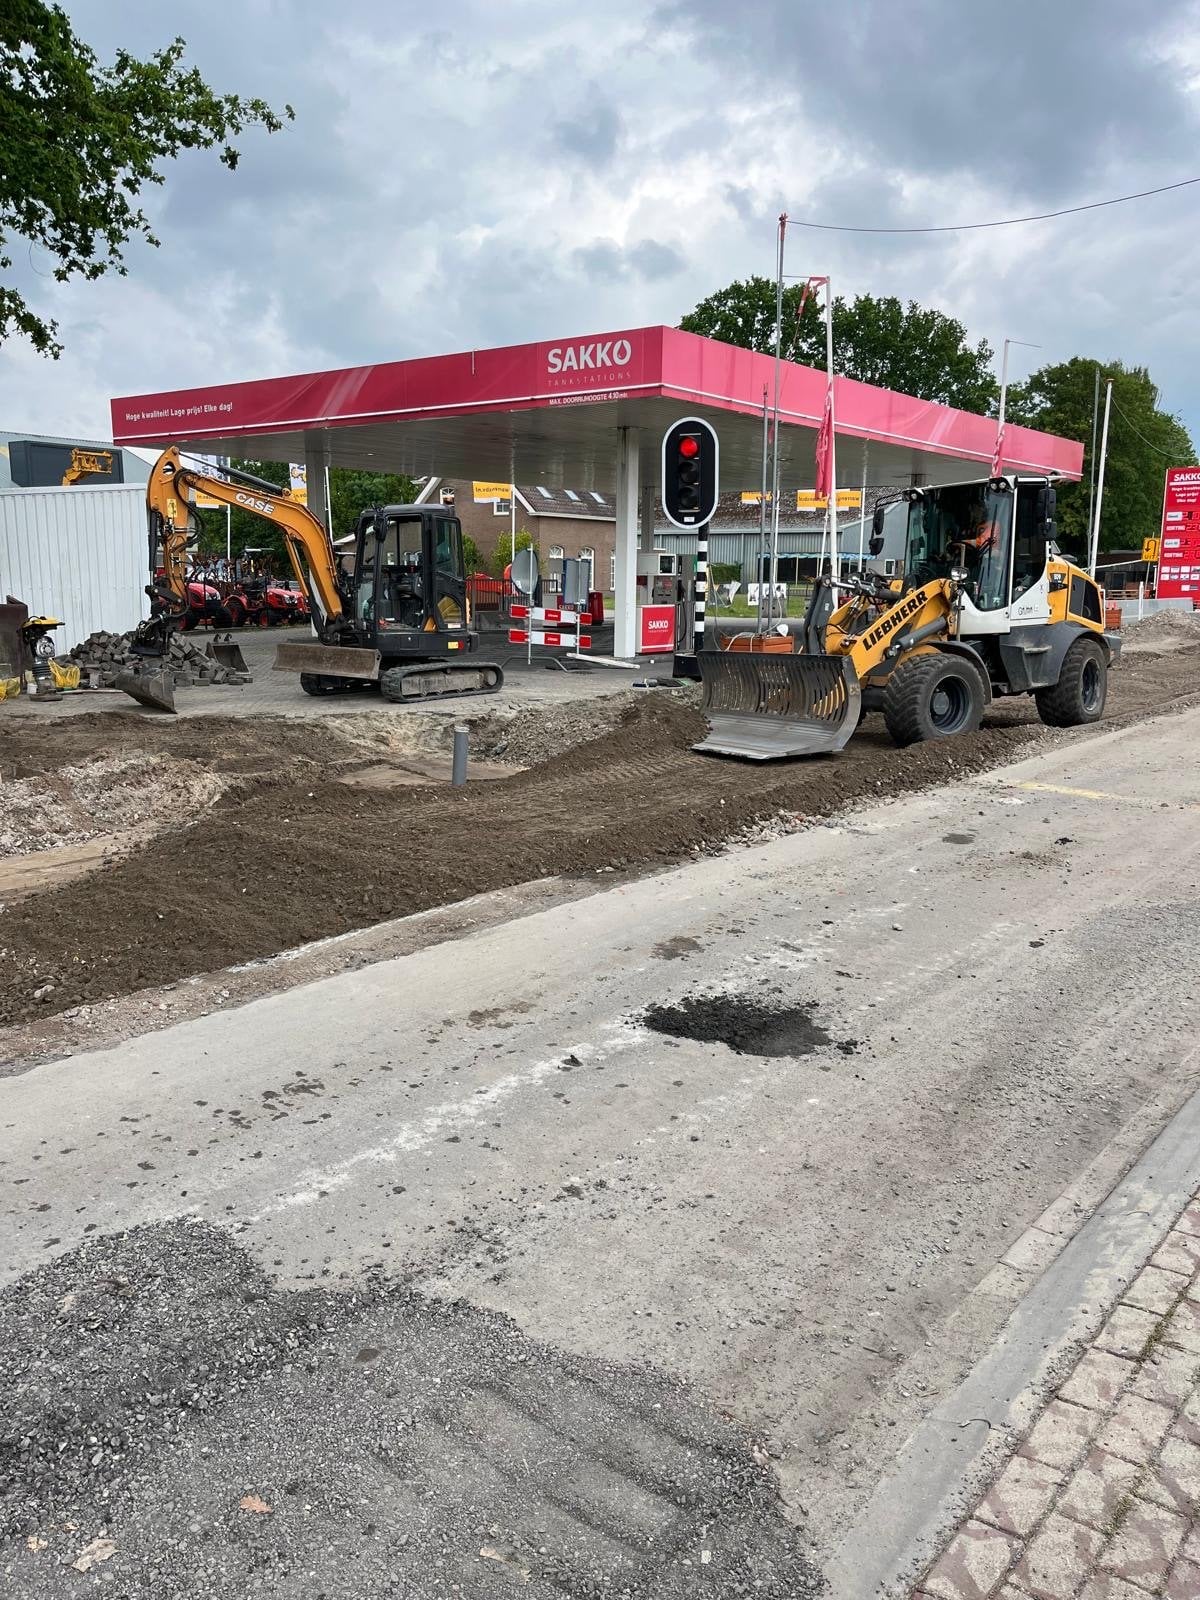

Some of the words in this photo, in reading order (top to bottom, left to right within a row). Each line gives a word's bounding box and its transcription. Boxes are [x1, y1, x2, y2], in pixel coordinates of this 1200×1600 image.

[548, 339, 632, 374] SAKKO
[548, 372, 631, 387] TANKSTATIONS
[126, 413, 140, 421] Hoge
[142, 409, 170, 418] kwaliteit!
[170, 408, 185, 417] Lage
[187, 405, 202, 415] prijs!
[204, 404, 217, 412] Elke
[219, 402, 232, 413] dag!
[235, 492, 274, 514] CASE
[648, 620, 668, 629] SAKKO
[862, 591, 928, 651] LIEBHERR
